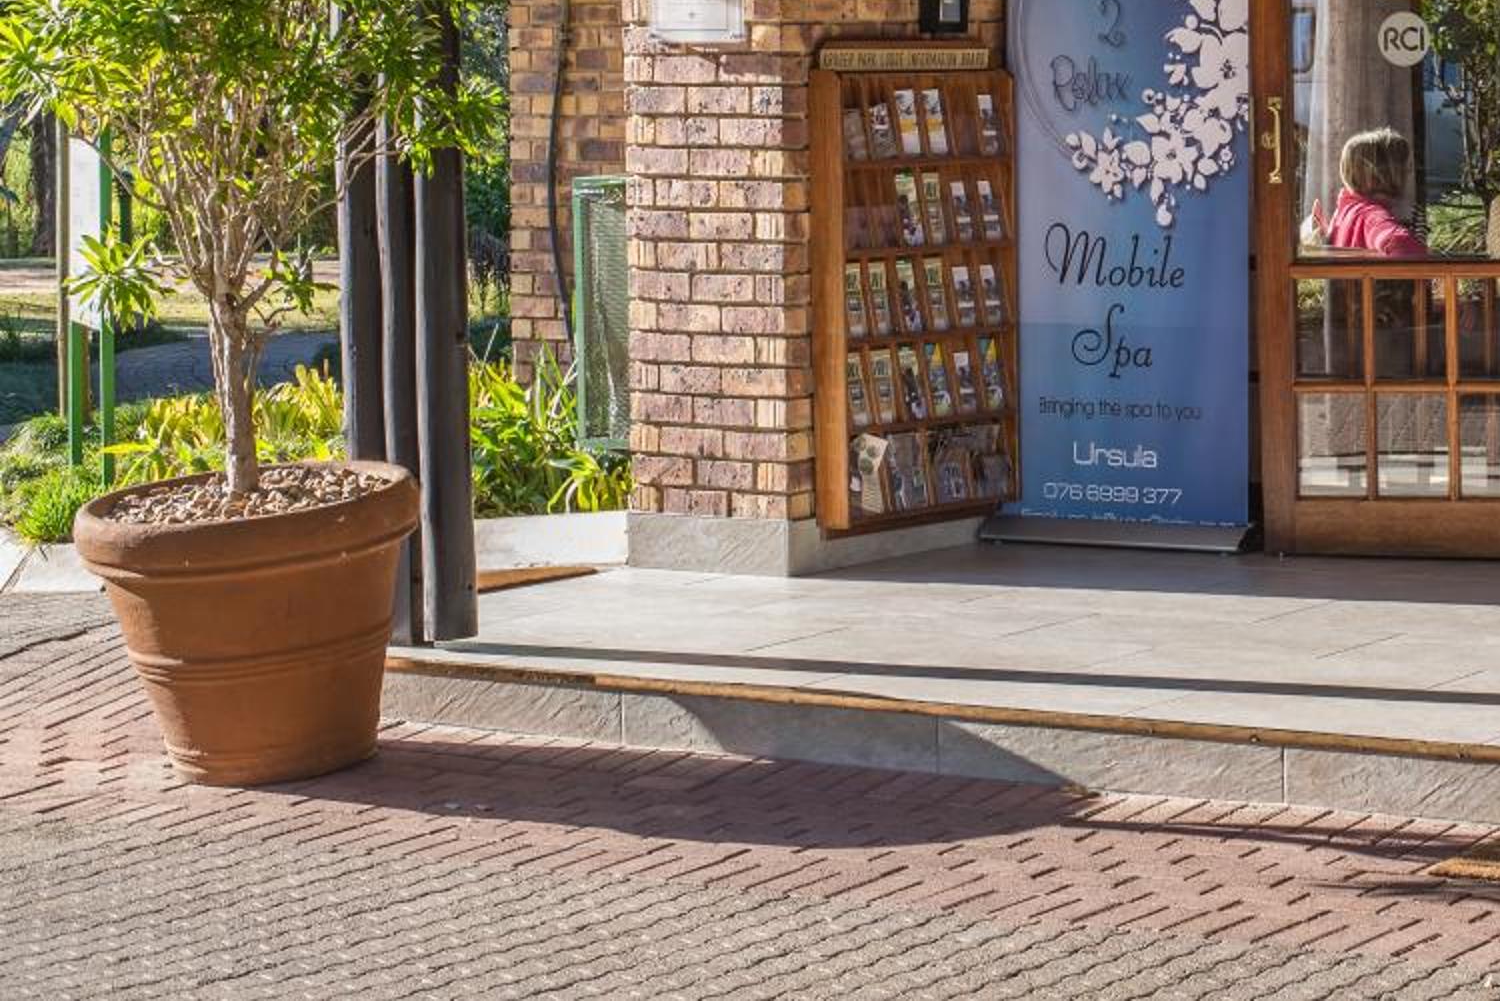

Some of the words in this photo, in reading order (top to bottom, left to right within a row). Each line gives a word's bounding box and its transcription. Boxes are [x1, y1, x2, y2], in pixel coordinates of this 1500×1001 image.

[1383, 26, 1425, 52] RCI
[1050, 54, 1132, 112] Relax
[1044, 222, 1185, 288] Mobile
[1071, 303, 1153, 379] Spa
[1039, 396, 1095, 420] Bringing
[1099, 398, 1121, 417] the
[1125, 403, 1152, 419] spa
[1155, 402, 1171, 419] to
[1173, 407, 1203, 422] you
[1073, 441, 1158, 469] Ursula
[1043, 482, 1083, 500] 076
[1142, 487, 1183, 505] 377
